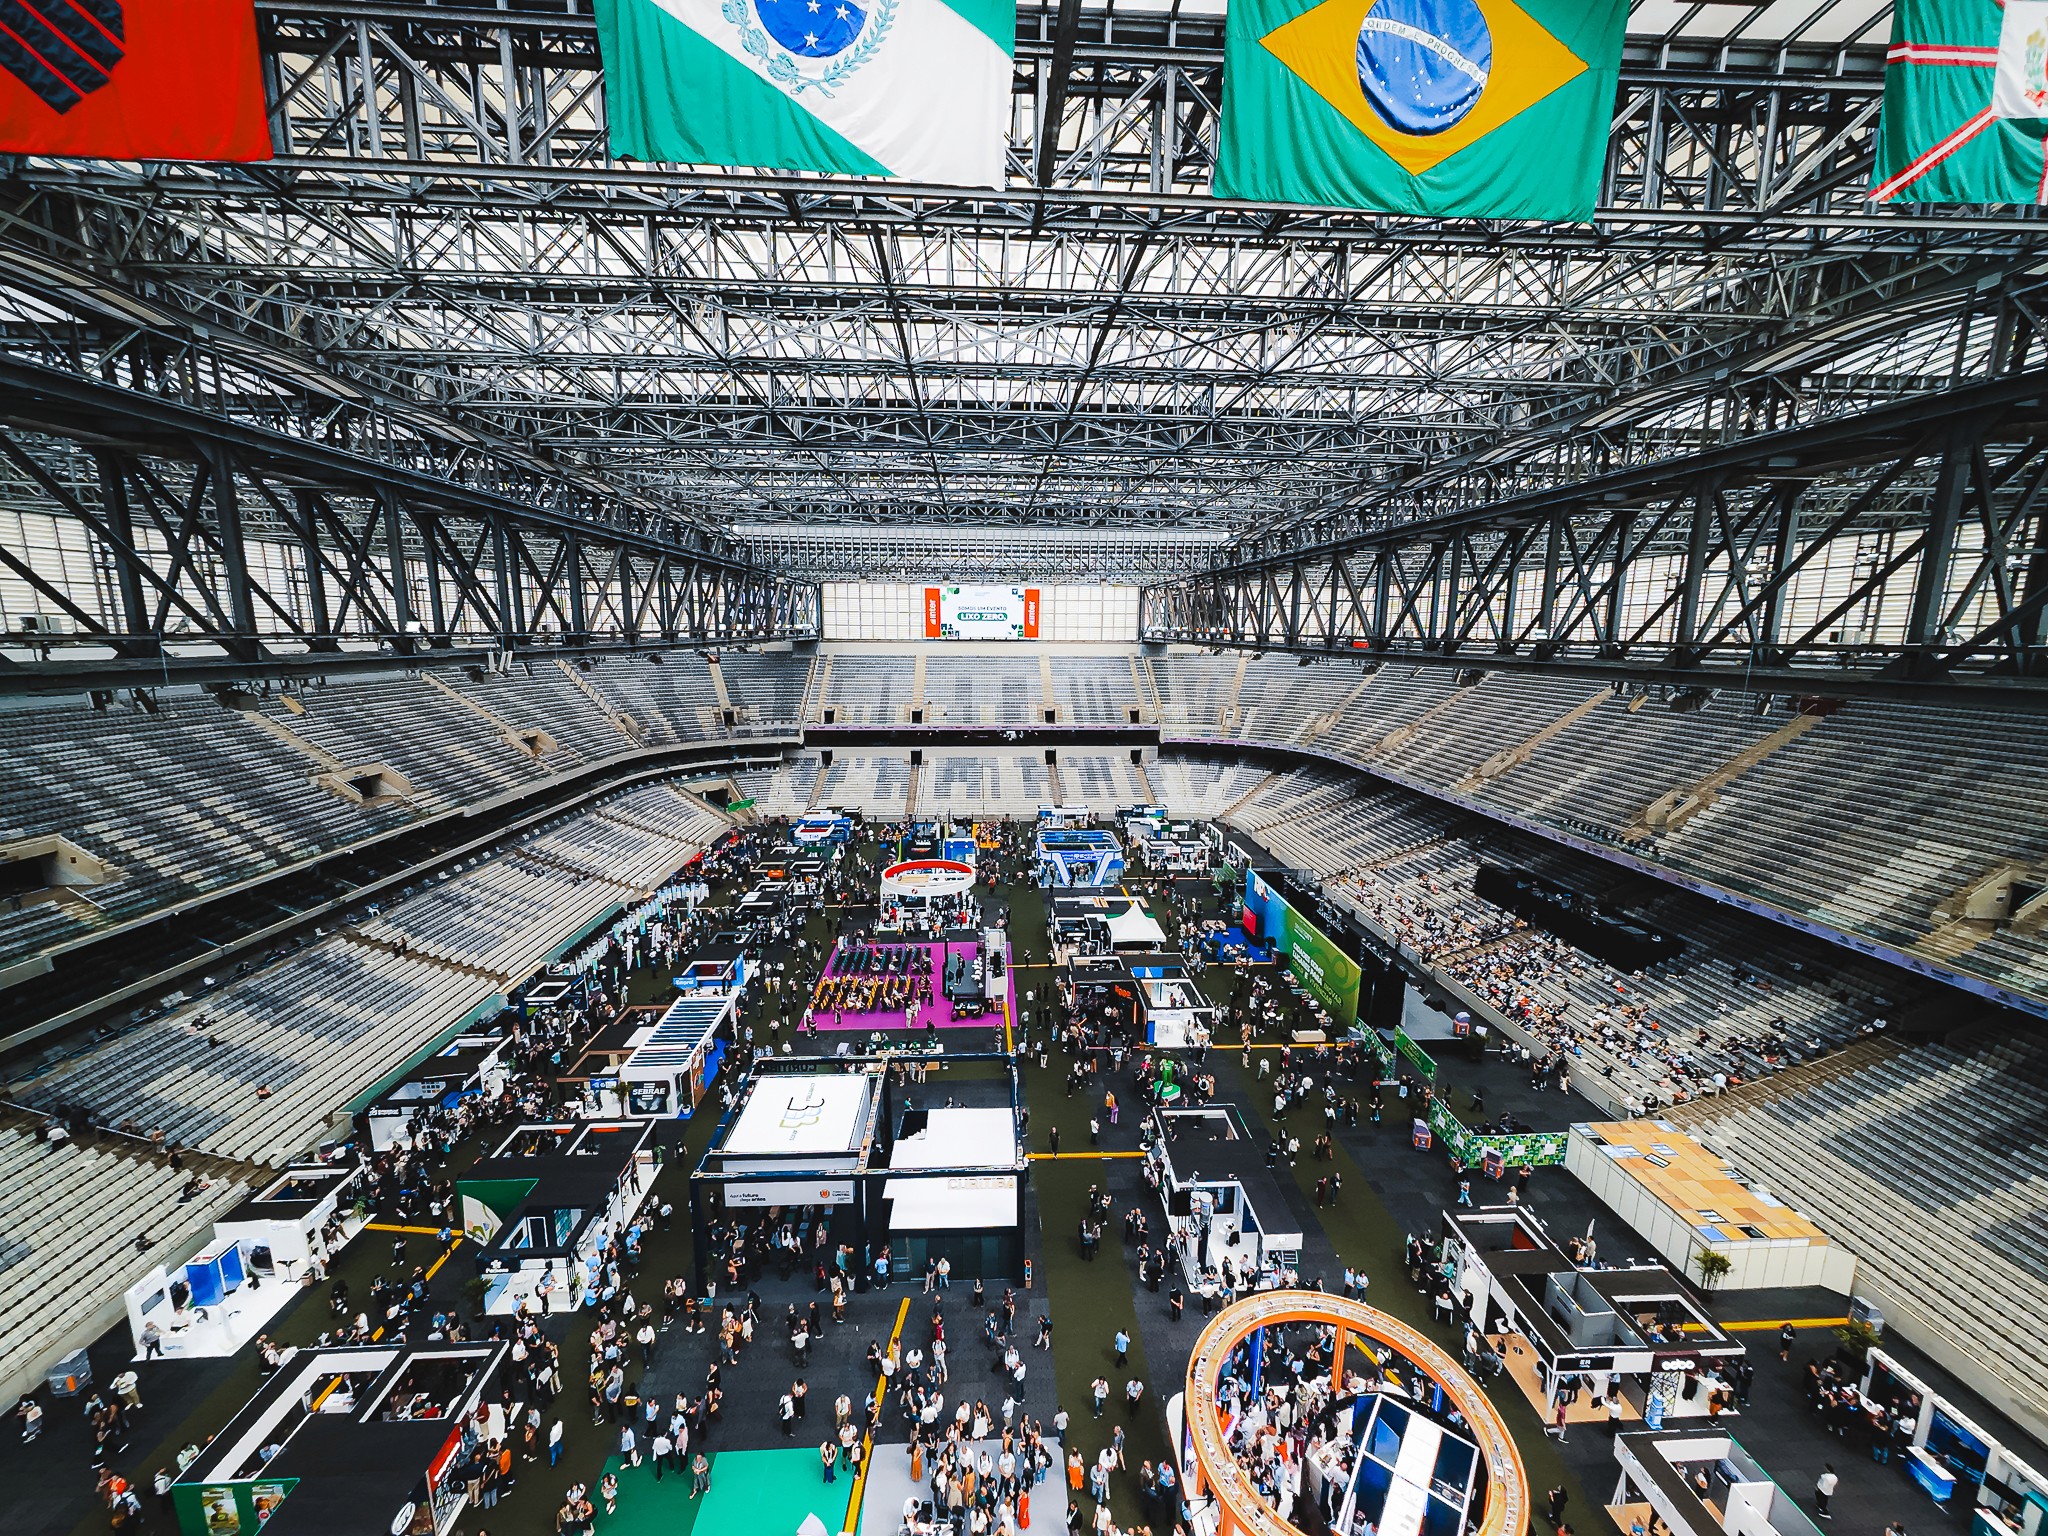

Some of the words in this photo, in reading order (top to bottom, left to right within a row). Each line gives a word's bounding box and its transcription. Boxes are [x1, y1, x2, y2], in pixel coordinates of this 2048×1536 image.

[1367, 19, 1406, 35] ORDEM
[1426, 37, 1486, 83] PROGRESSO
[1028, 601, 1036, 626] inter
[632, 1087, 666, 1096] SEBRAE
